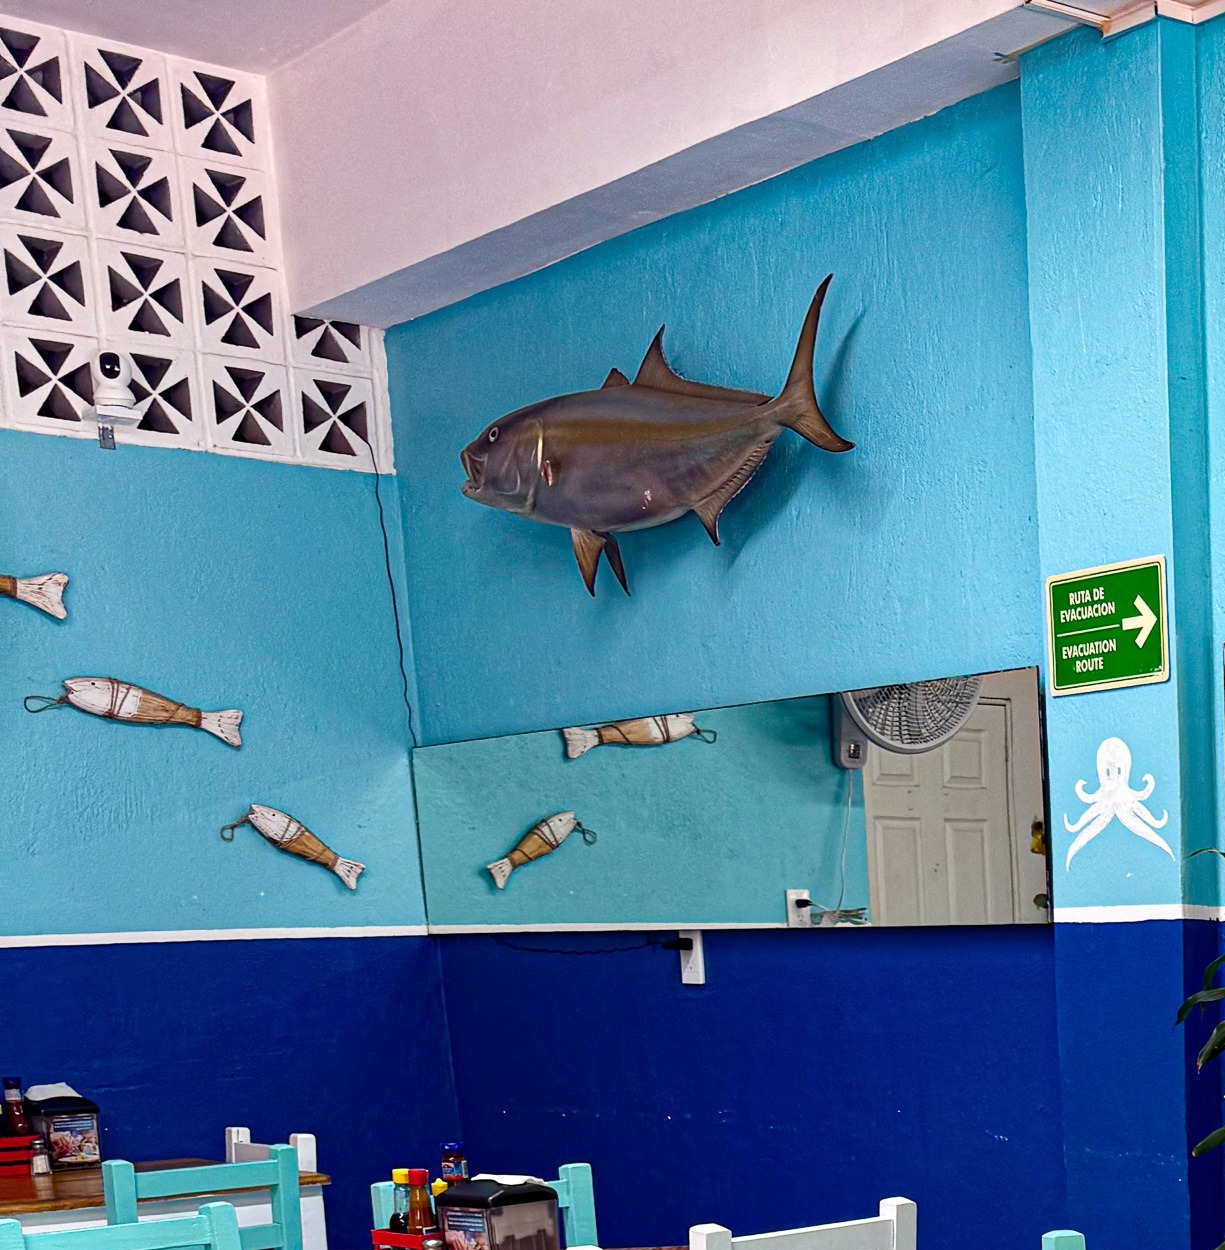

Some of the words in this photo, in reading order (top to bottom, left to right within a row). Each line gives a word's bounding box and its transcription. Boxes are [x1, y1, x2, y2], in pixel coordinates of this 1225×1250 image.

[1069, 590, 1091, 605] RUTA
[1093, 587, 1104, 601] DE
[1060, 602, 1115, 623] EVACUACION
[1062, 639, 1116, 659] EVACUATION
[1076, 657, 1103, 673] ROUTE
